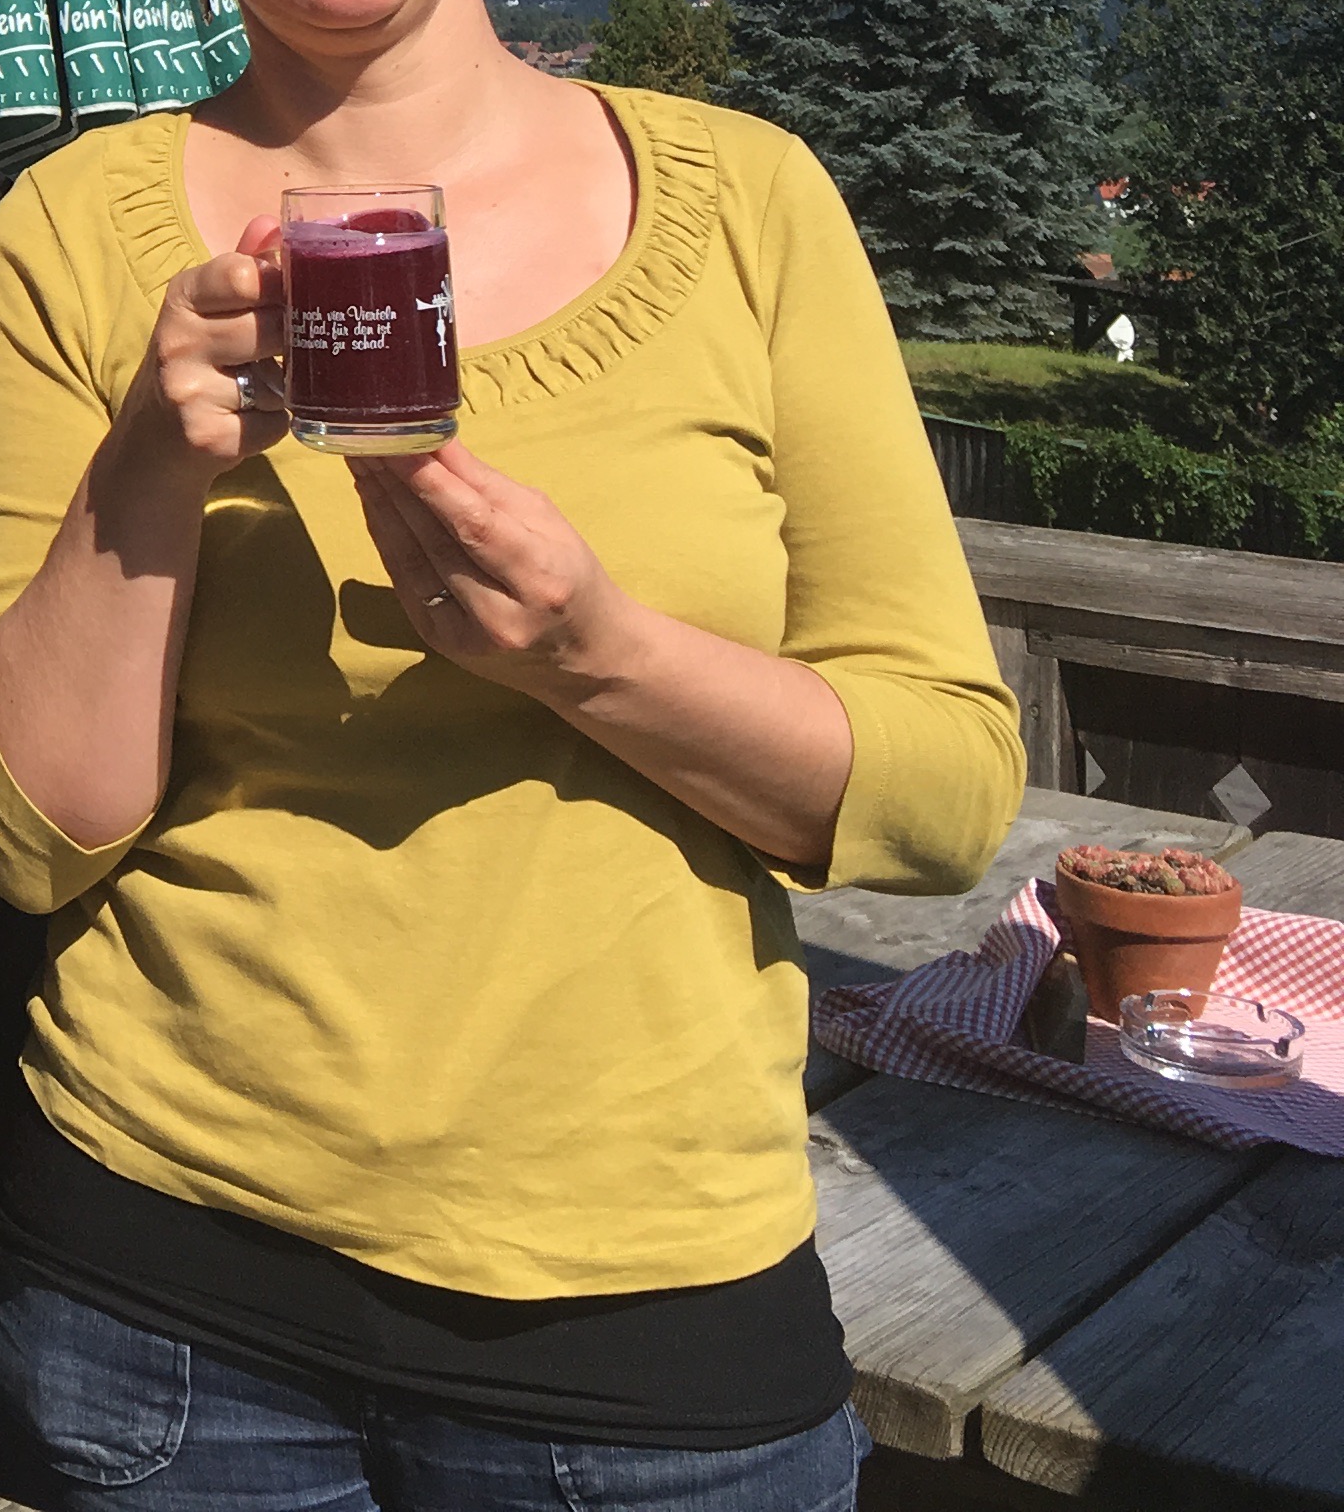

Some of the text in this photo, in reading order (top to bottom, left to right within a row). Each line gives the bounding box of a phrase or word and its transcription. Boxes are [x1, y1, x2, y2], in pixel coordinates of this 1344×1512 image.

[302, 306, 323, 321] nach
[327, 310, 346, 322] vier
[346, 305, 397, 322] Vierteln
[353, 321, 374, 336] den
[377, 321, 392, 336] ist
[332, 341, 346, 356] zu
